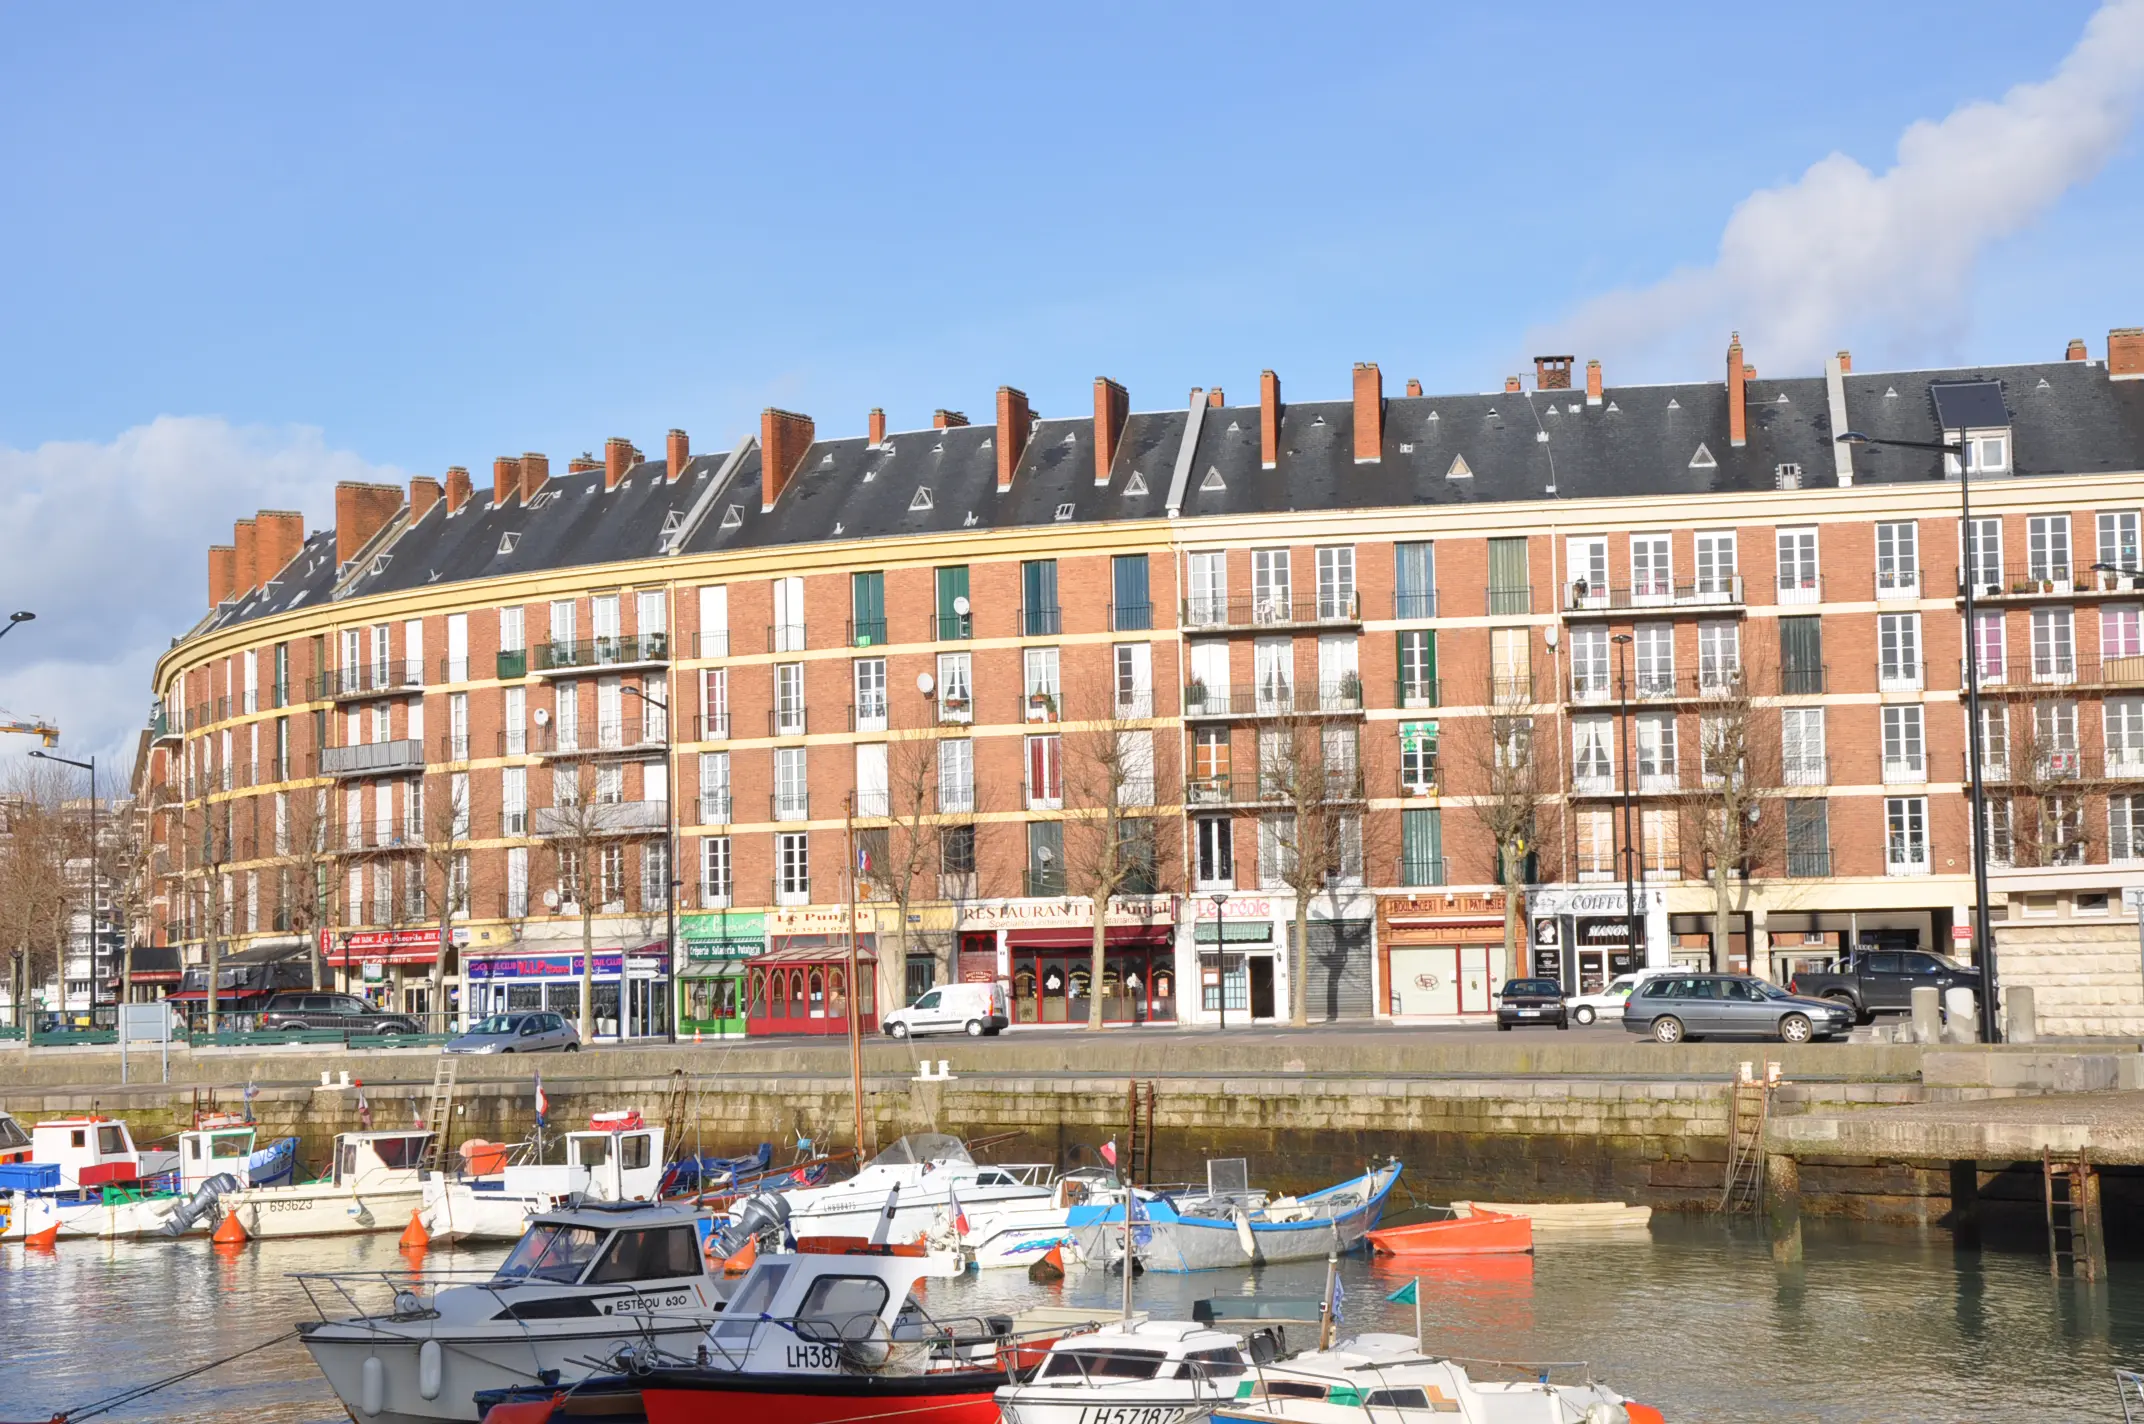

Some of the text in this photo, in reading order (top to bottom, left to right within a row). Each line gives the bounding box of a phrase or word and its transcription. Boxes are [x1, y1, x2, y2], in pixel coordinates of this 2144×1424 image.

[964, 904, 1080, 920] RESTAURANT
[1196, 899, 1216, 917] Le
[1588, 924, 1629, 937] MANON
[665, 1295, 687, 1307] 630
